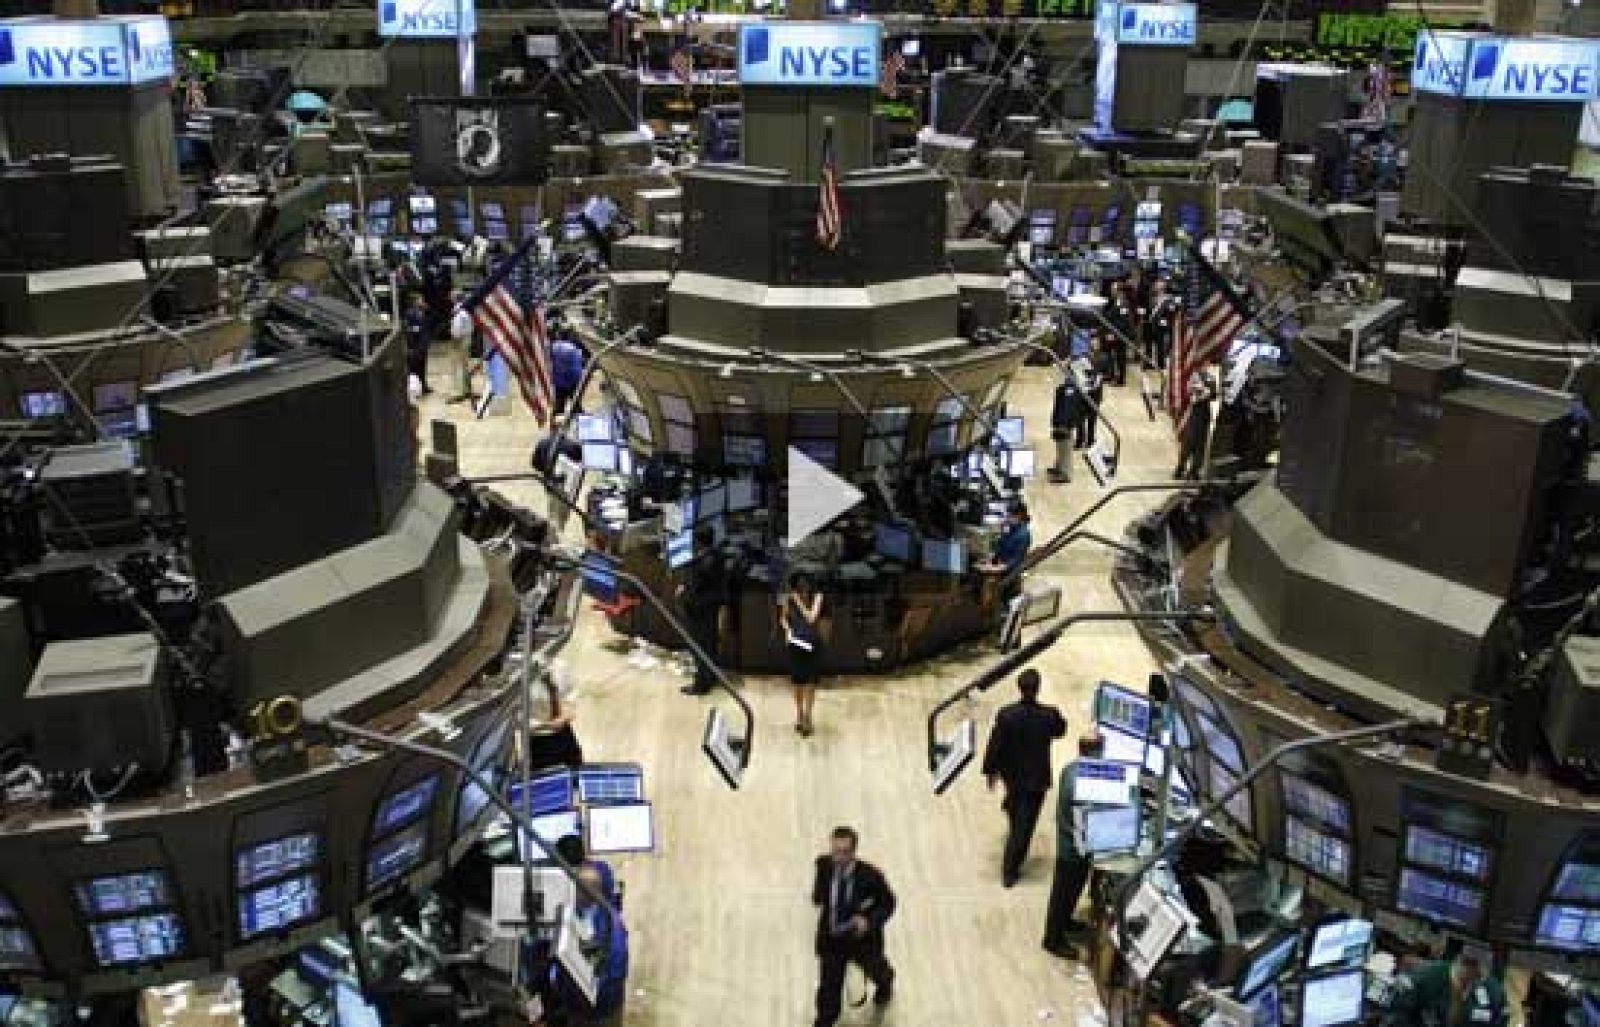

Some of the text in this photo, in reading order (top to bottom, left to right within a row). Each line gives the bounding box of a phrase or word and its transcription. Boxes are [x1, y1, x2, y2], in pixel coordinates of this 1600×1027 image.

[402, 11, 458, 30] NYSE
[1140, 20, 1194, 38] NYSE
[27, 46, 121, 78] NYSE
[781, 46, 872, 77] NYSE
[1503, 63, 1592, 94] NYSE
[250, 695, 301, 742] 10
[1448, 700, 1491, 743] 11
